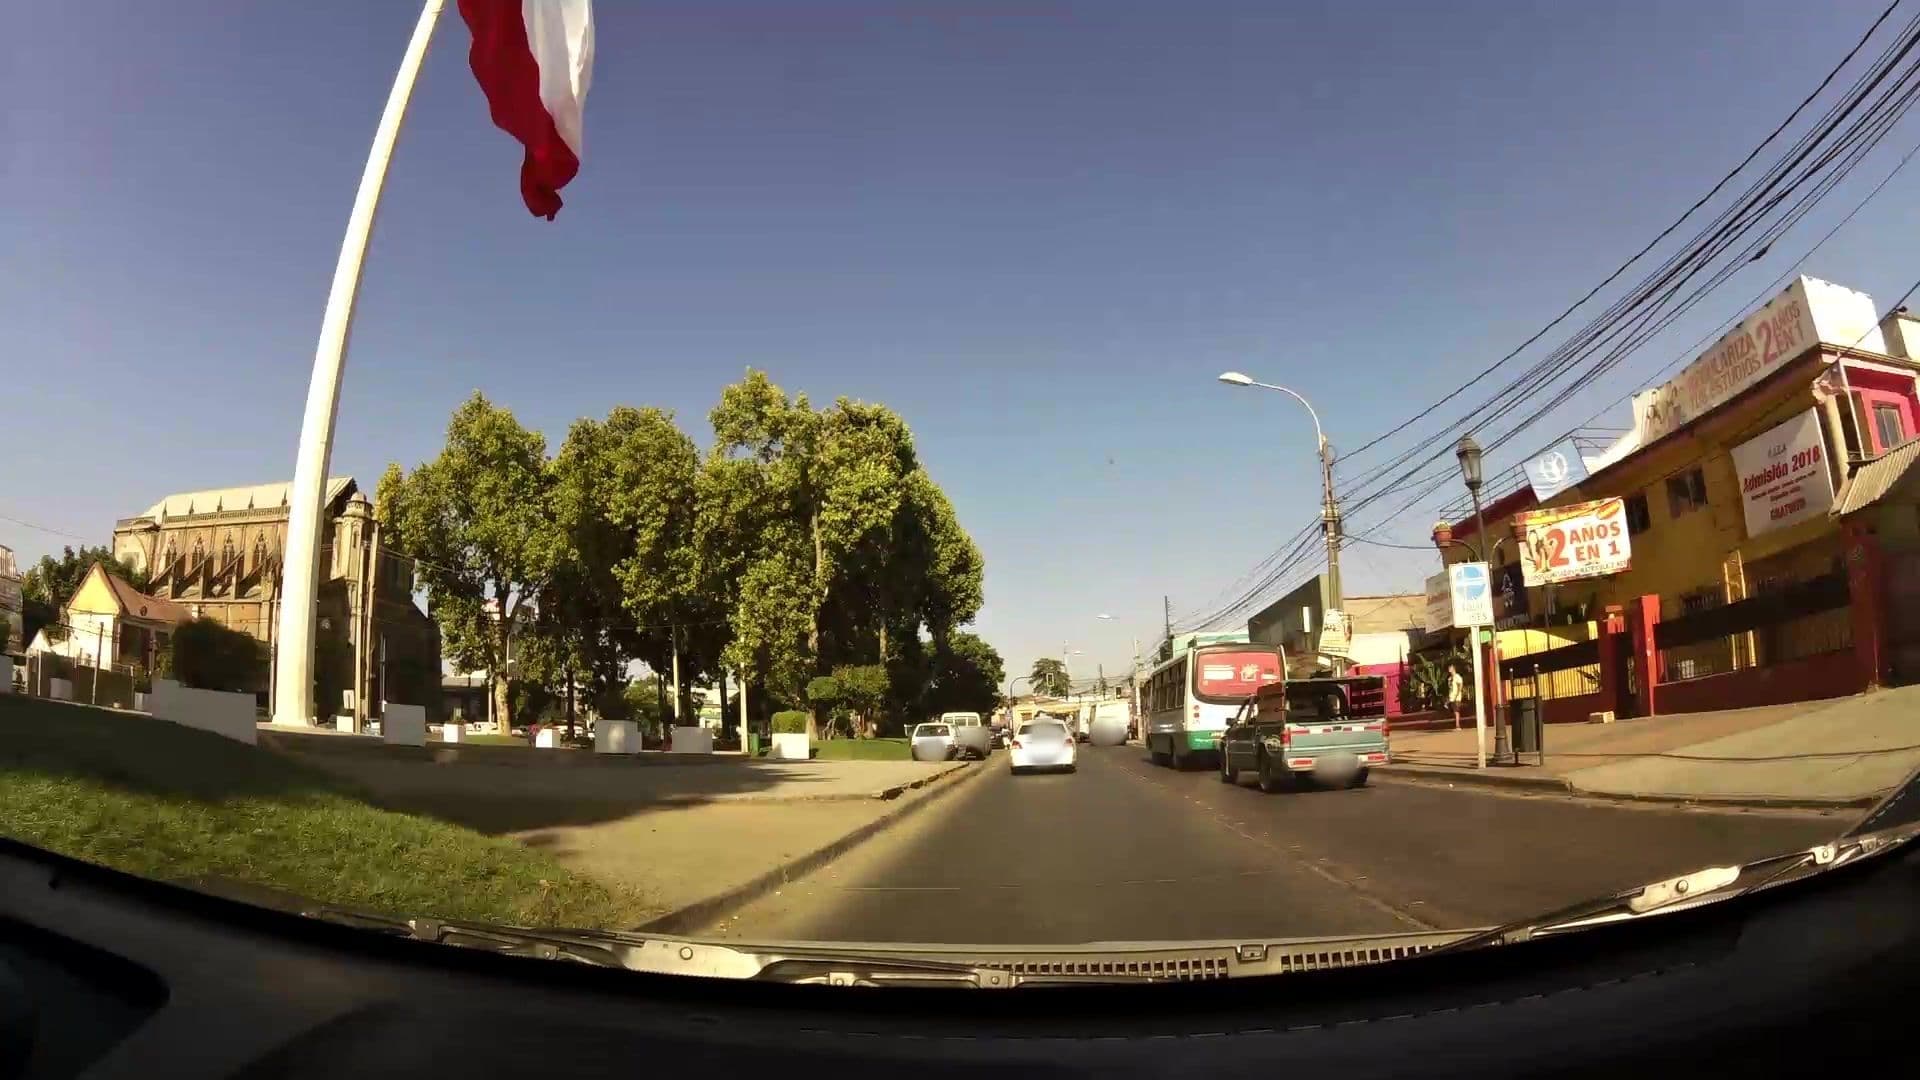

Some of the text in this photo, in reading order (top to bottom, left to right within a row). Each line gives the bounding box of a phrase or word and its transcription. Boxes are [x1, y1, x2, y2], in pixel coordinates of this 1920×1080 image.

[1757, 320, 1777, 365] 2
[1775, 329, 1796, 358] EN
[1743, 461, 1789, 494] Admisión
[1546, 528, 1570, 567] 2
[1575, 540, 1621, 562] EN 1
